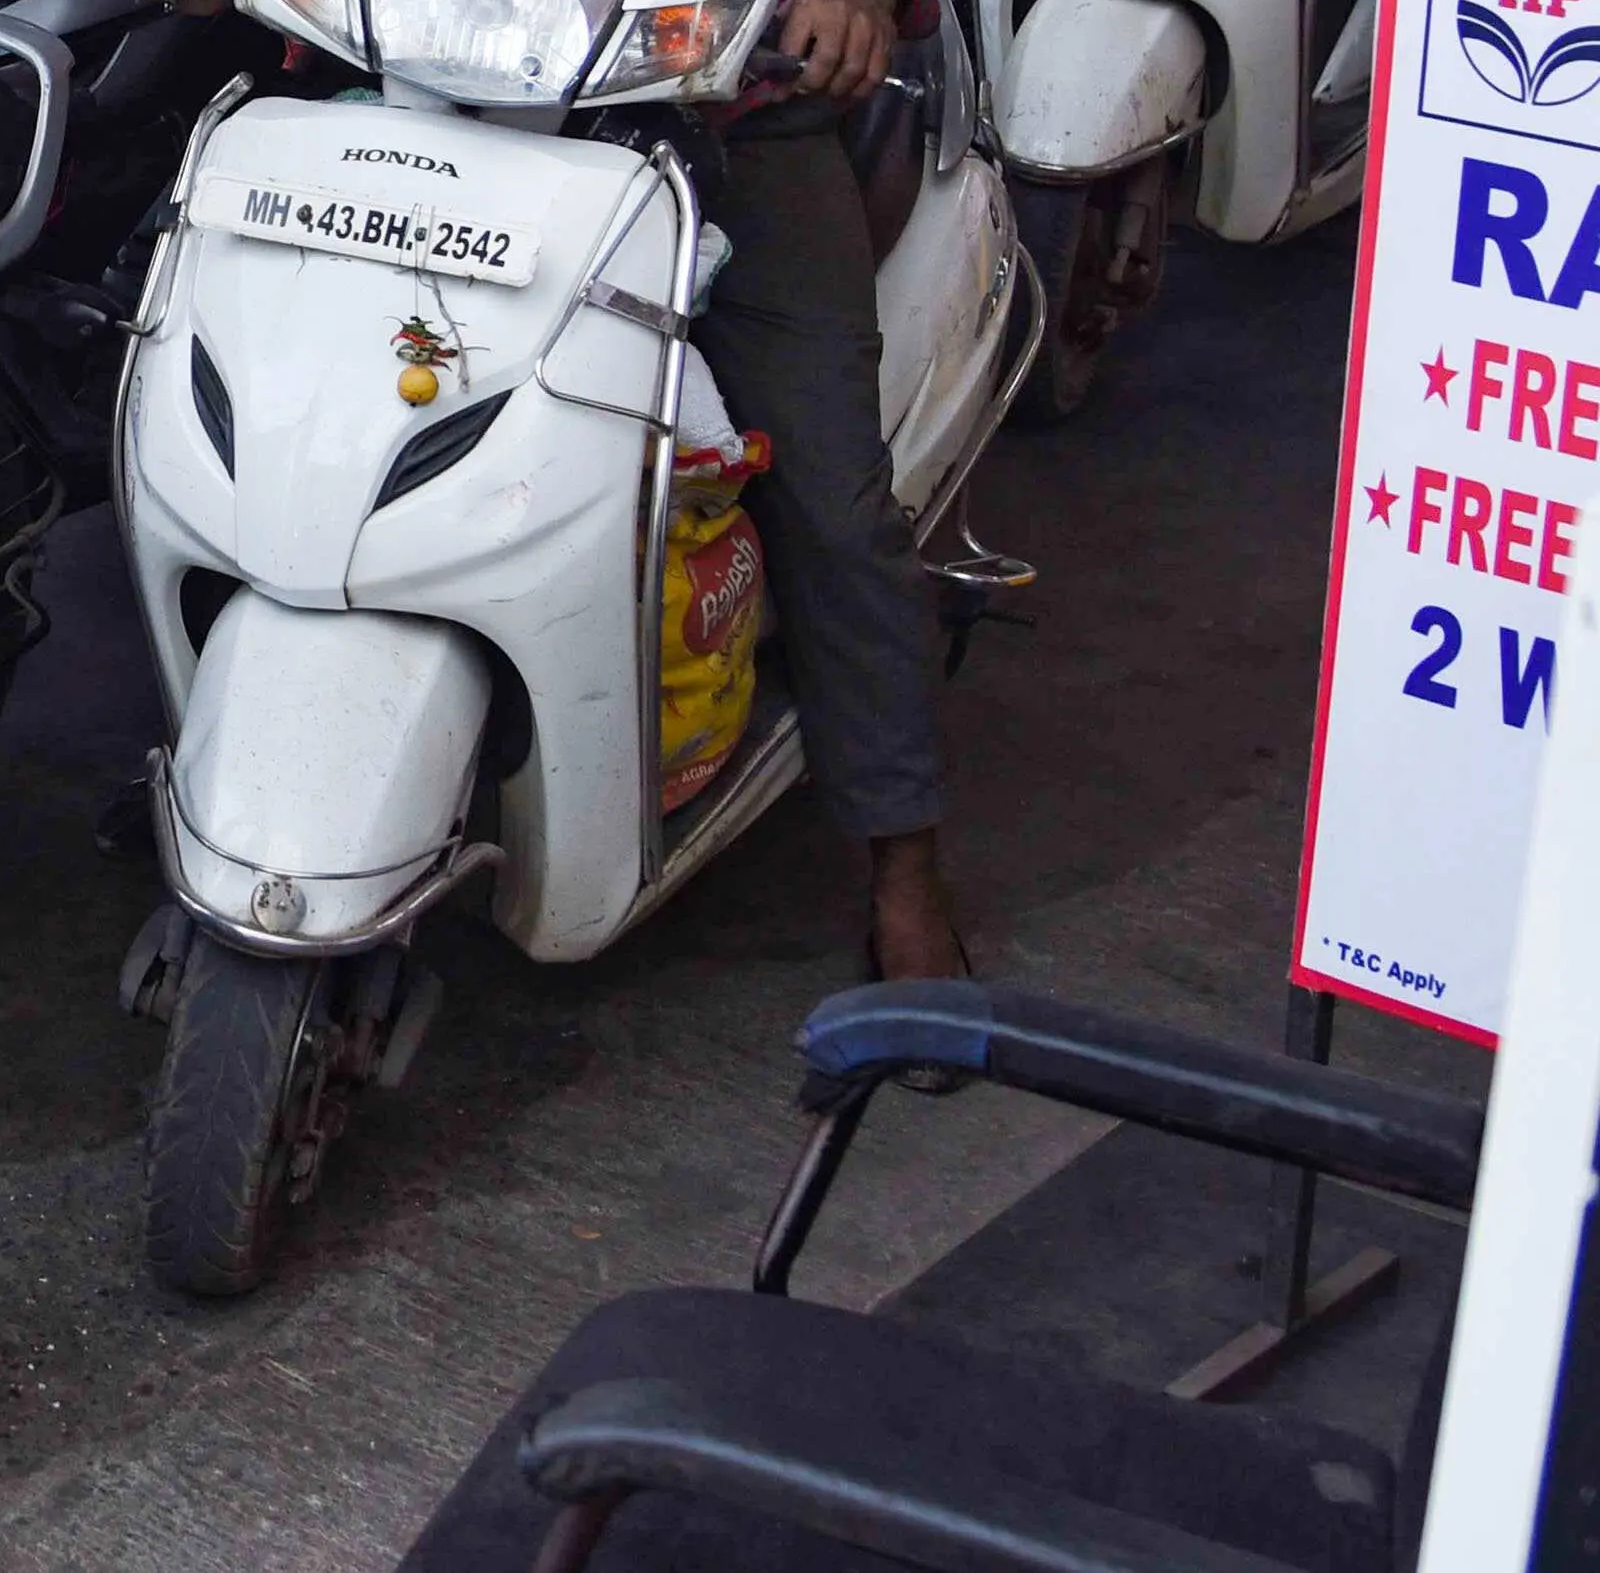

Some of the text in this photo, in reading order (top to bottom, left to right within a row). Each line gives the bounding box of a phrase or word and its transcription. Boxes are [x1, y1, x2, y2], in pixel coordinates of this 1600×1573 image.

[341, 147, 461, 179] HONDA
[431, 222, 511, 268] 2542
[1402, 604, 1463, 710] 2
[1337, 942, 1447, 999] T&C Apply
